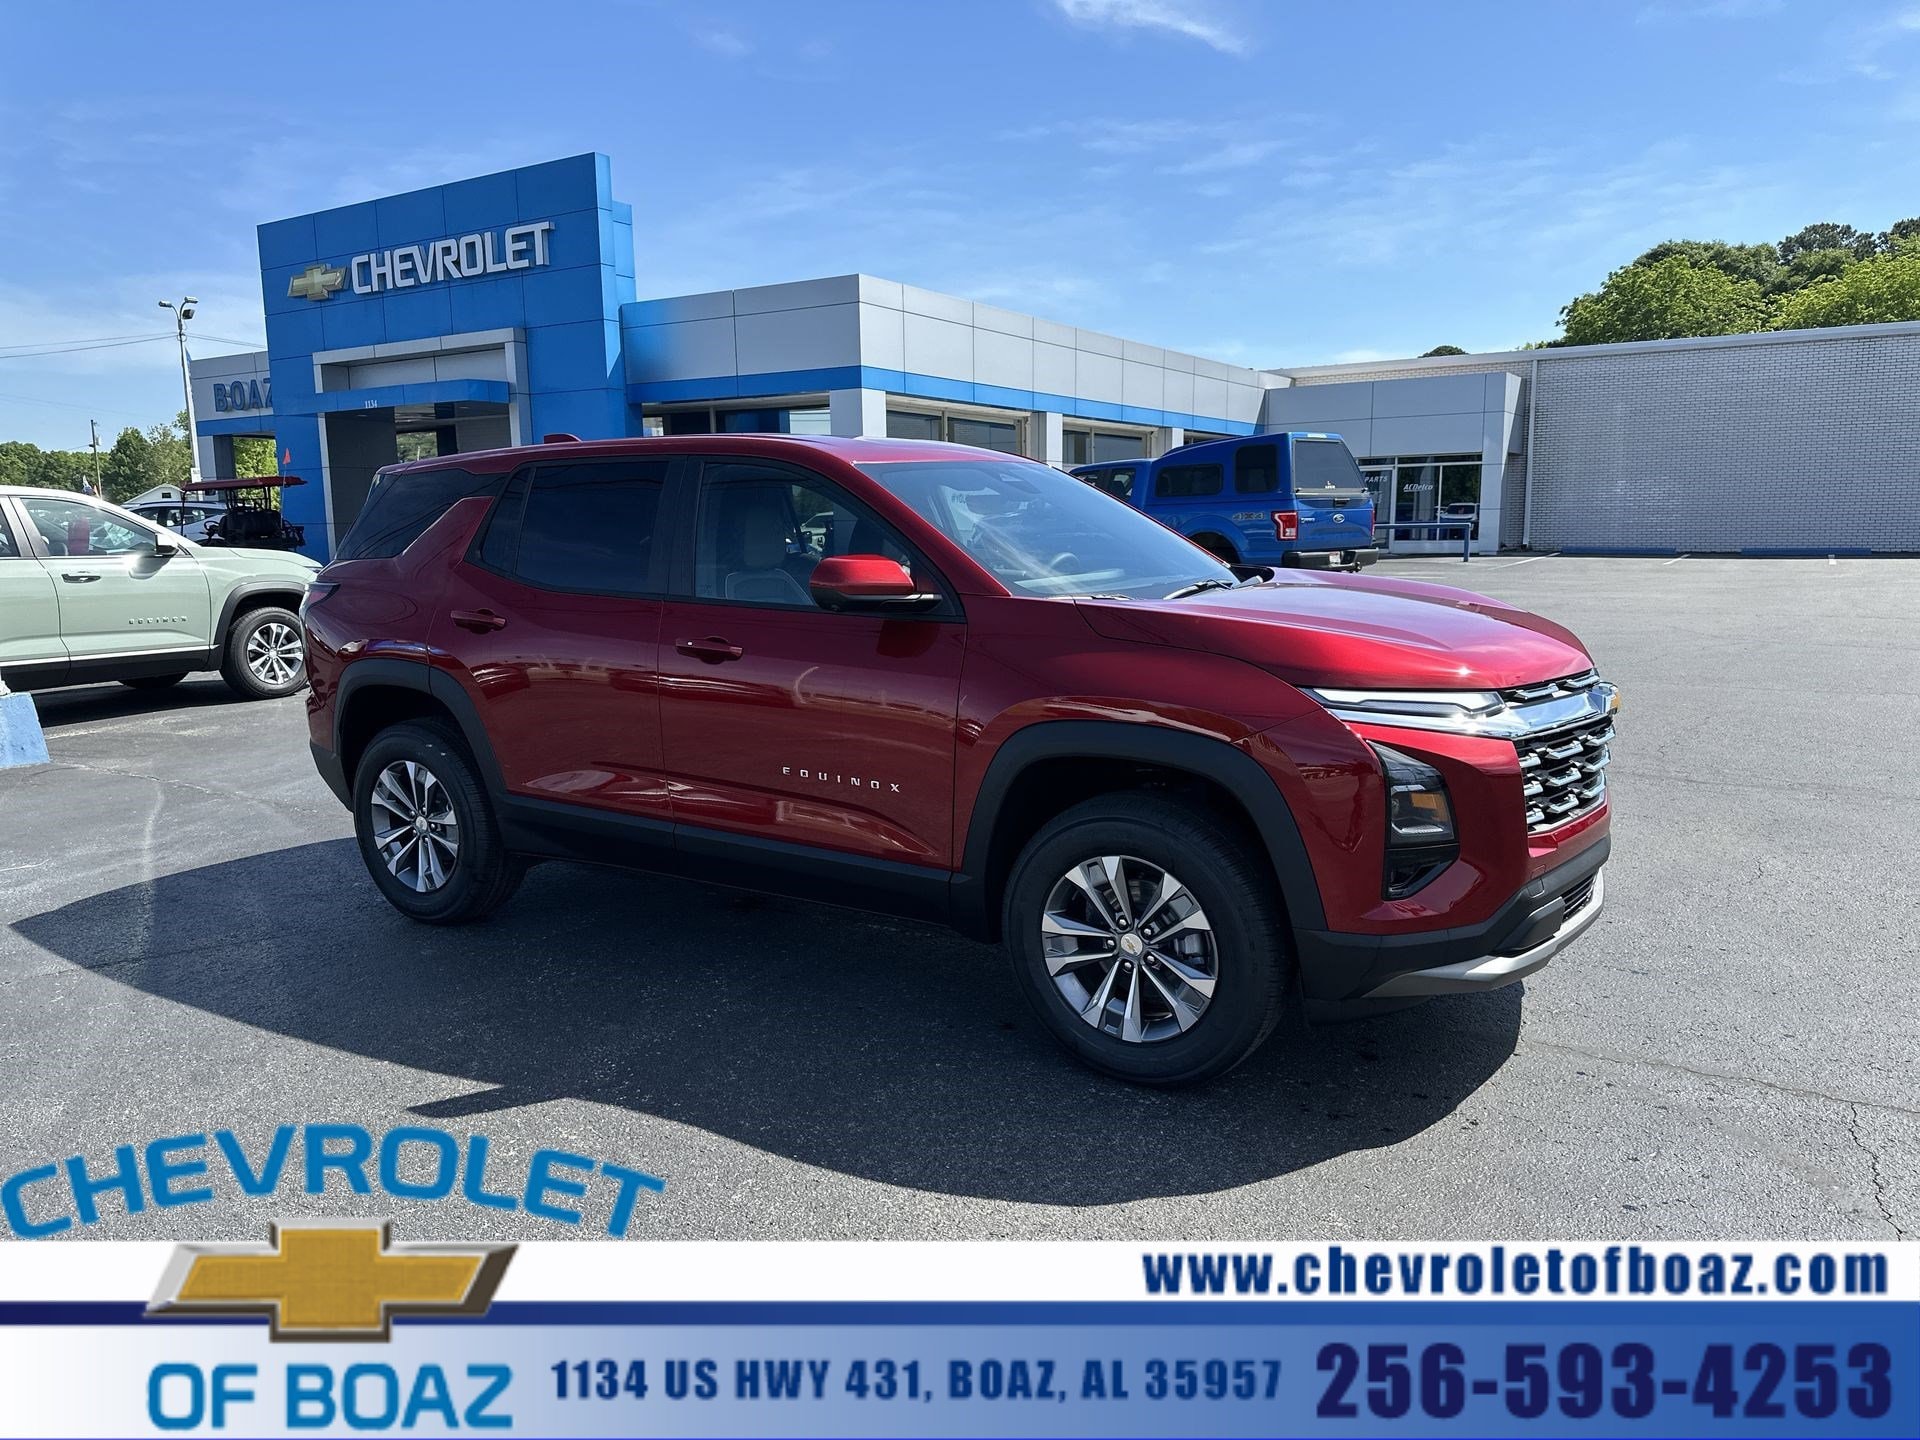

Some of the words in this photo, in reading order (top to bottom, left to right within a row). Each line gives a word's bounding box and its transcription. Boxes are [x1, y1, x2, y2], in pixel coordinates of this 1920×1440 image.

[351, 221, 555, 294] CHEVROLET
[1364, 475, 1388, 483] PARTS
[1403, 483, 1434, 492] ACDelco
[782, 766, 900, 793] EQUINOX
